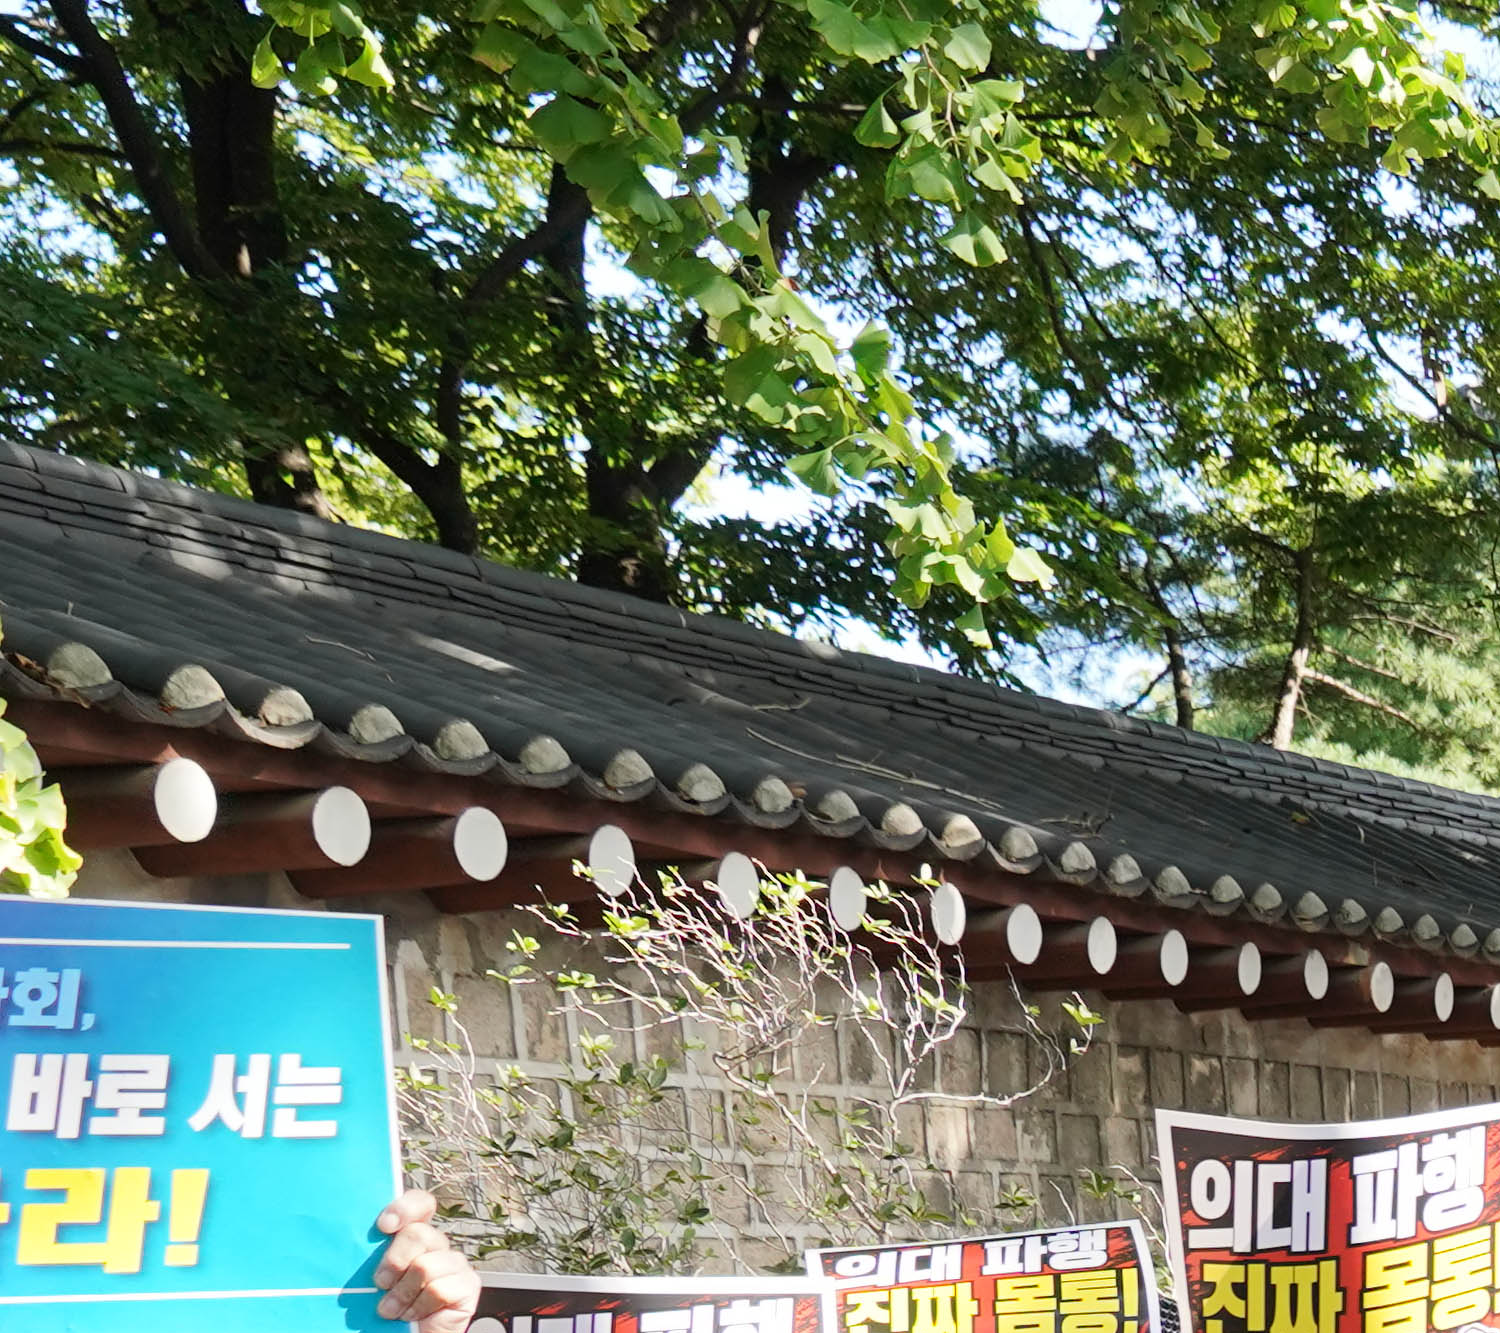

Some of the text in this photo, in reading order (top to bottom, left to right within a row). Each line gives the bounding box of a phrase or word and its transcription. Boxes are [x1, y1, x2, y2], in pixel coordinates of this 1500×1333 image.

[7, 1053, 342, 1138] 바로 서는
[0, 1166, 210, 1273] 라!
[1189, 1125, 1486, 1254] 의대 파행
[834, 1231, 1109, 1286] 의대 파행
